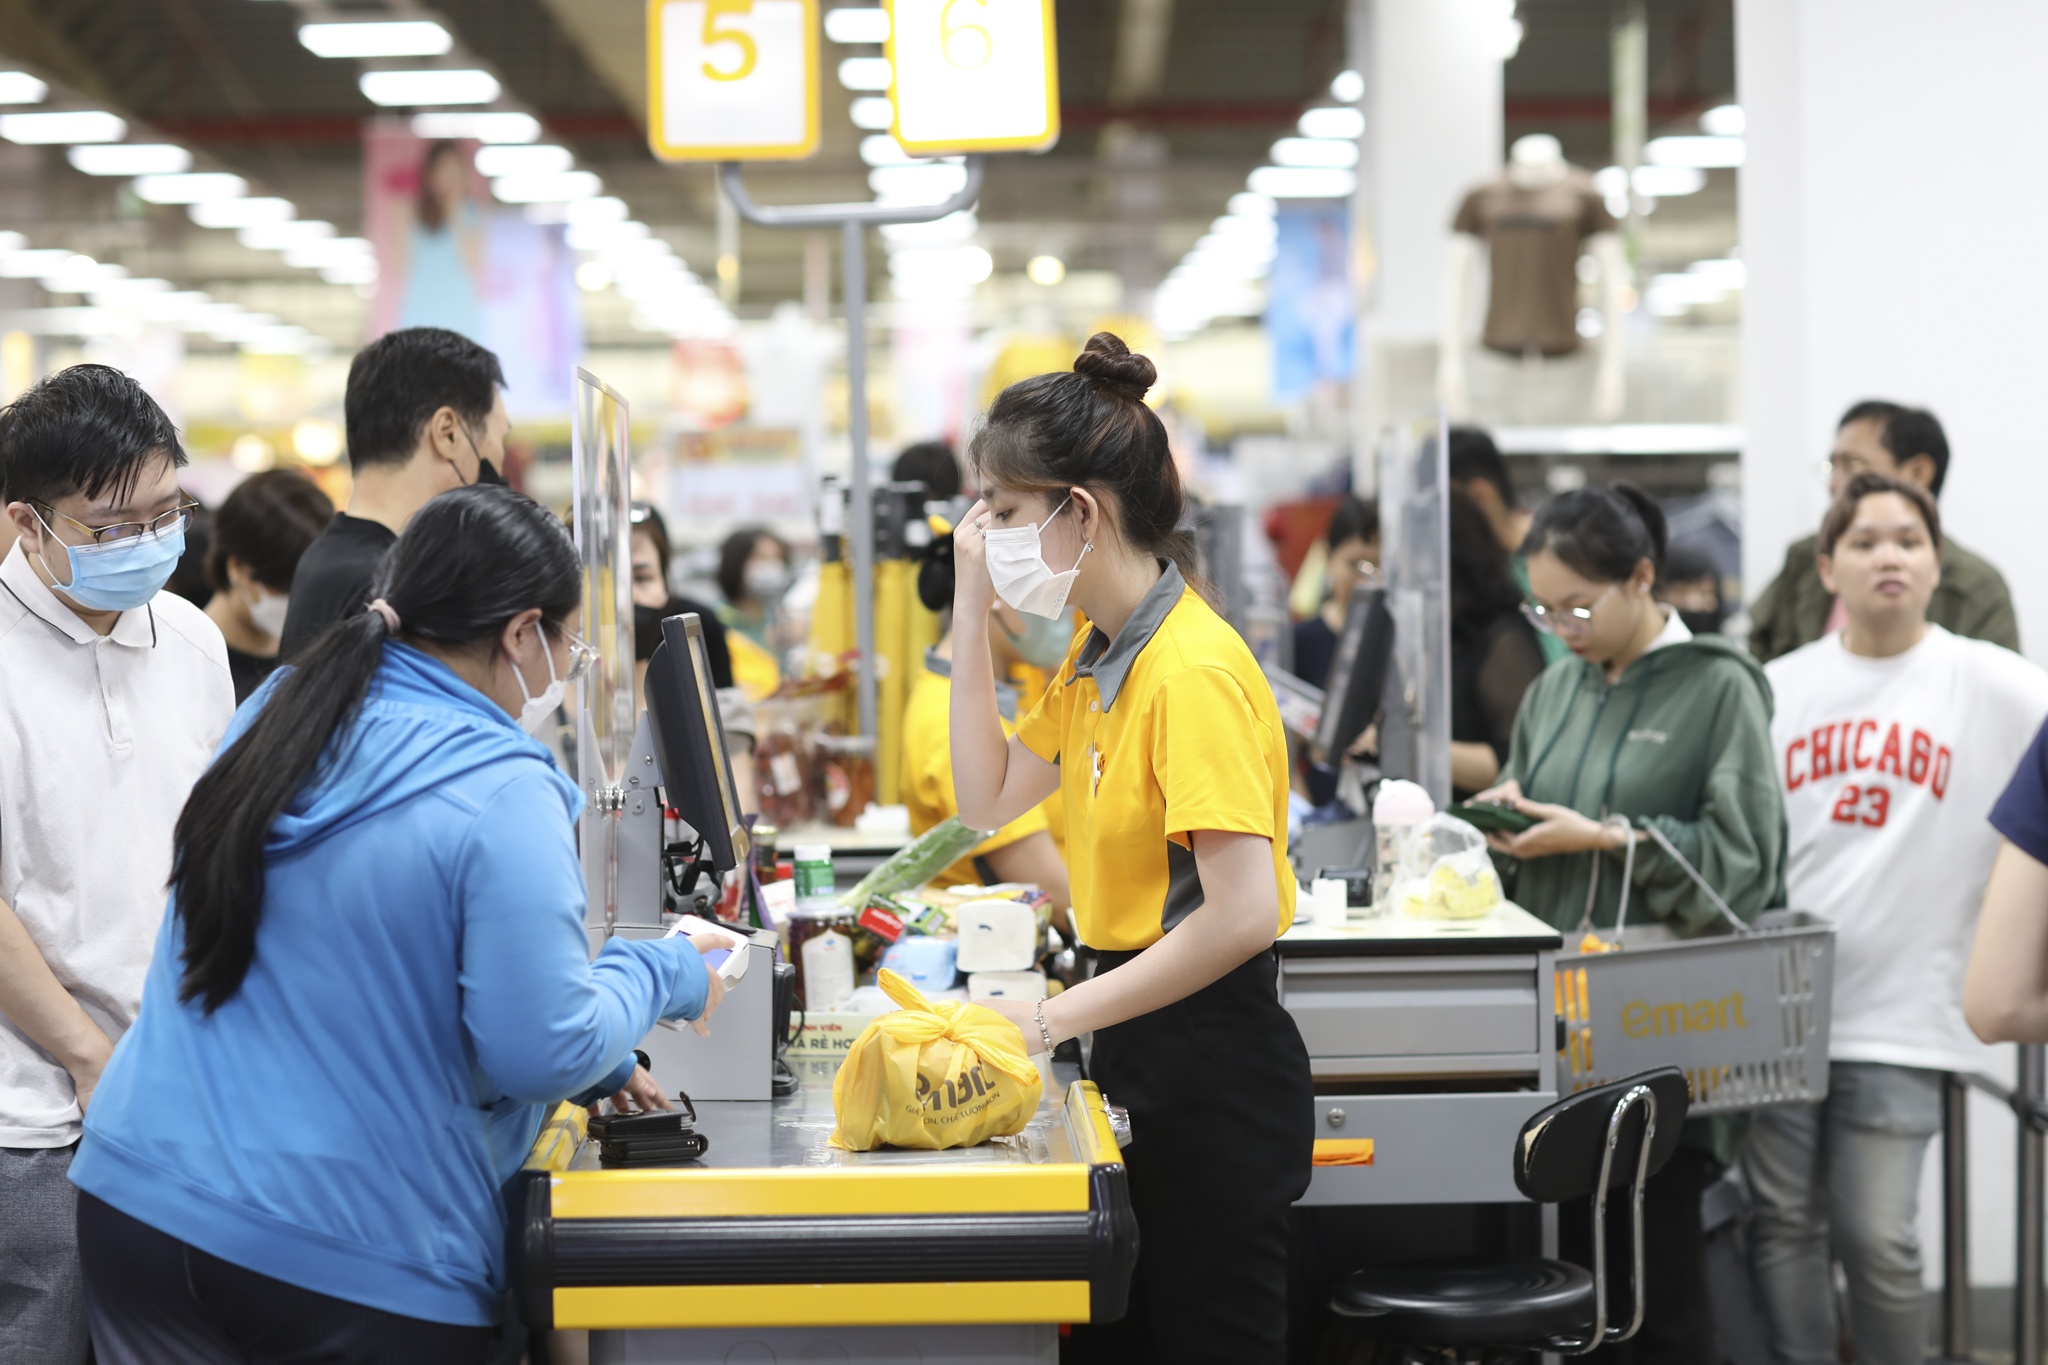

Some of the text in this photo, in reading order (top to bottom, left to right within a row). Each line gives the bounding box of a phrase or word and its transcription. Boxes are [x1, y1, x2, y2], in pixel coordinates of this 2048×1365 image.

[701, 0, 757, 81] 5
[939, 0, 992, 71] 6
[1786, 719, 1951, 799] CHICAGO
[1832, 785, 1890, 828] 23
[1621, 989, 1748, 1039] emart
